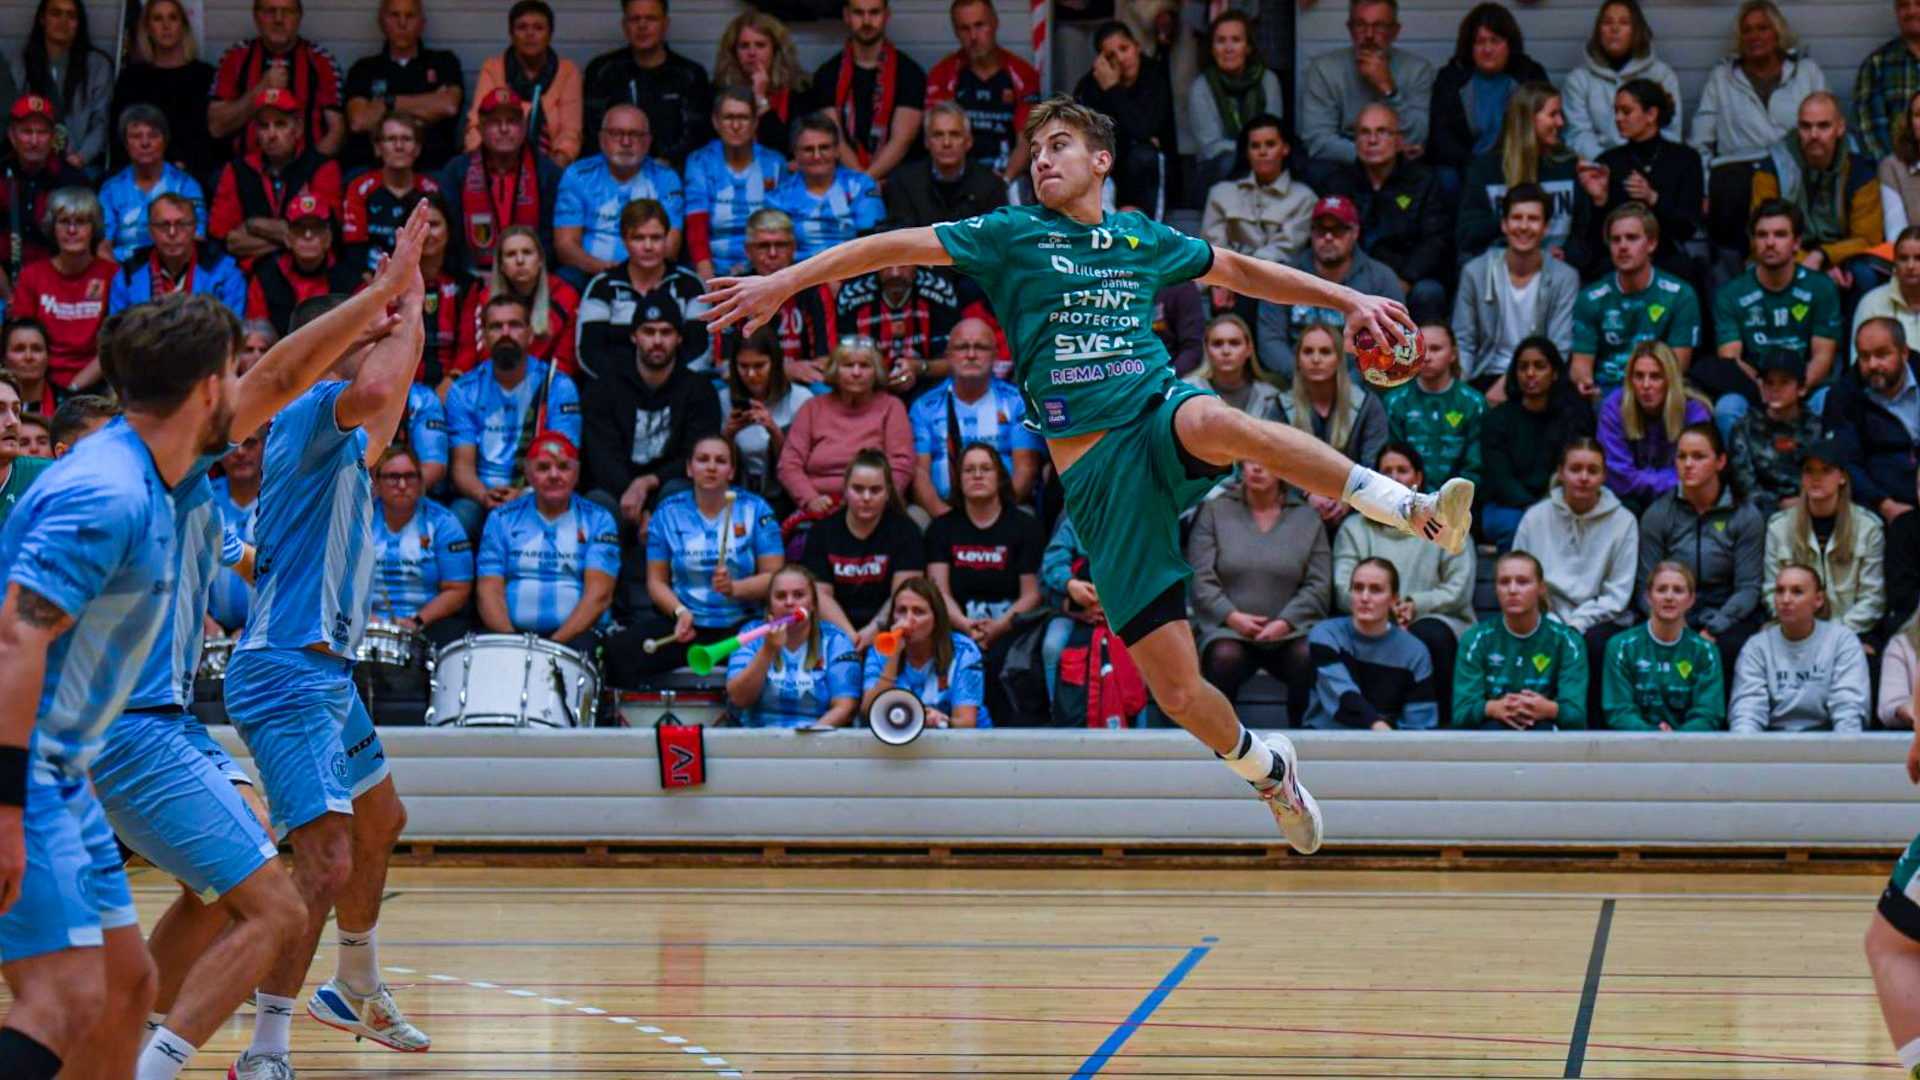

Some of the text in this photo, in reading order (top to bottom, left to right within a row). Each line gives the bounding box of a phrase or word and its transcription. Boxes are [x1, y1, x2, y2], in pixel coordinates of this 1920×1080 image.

[1050, 312, 1140, 327] PROTECTOR
[1050, 359, 1146, 385] REMA 1000
